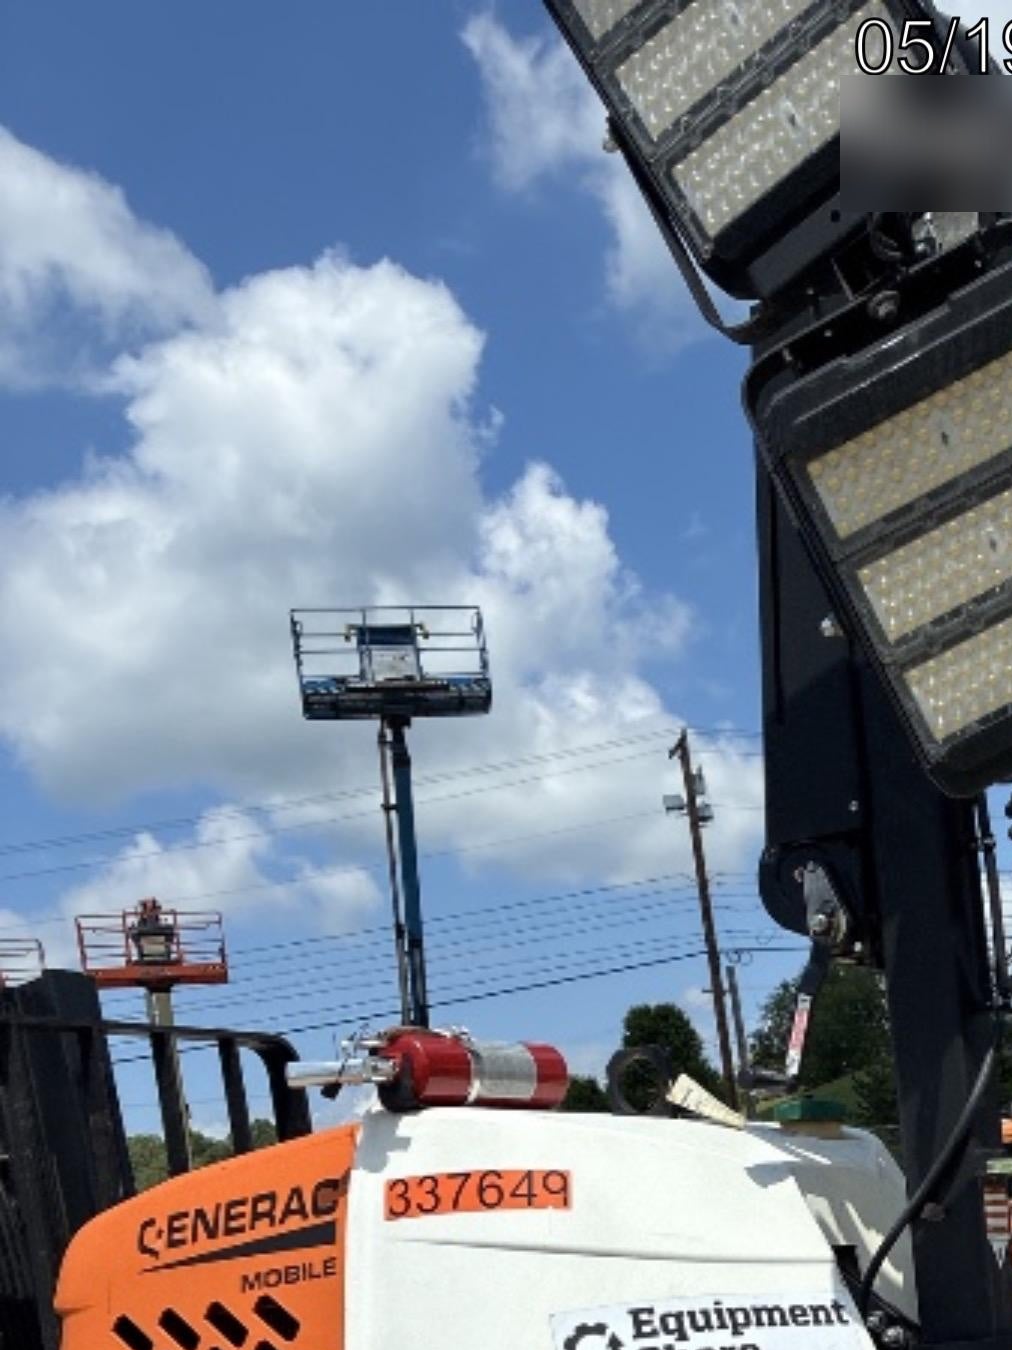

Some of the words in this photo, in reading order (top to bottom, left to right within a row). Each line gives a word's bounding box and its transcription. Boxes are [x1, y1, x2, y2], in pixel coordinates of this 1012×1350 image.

[388, 1170, 569, 1217] 337649
[137, 1178, 340, 1259] GENERAC
[240, 1256, 337, 1293] MOBILE
[627, 1299, 849, 1342] Equipment
